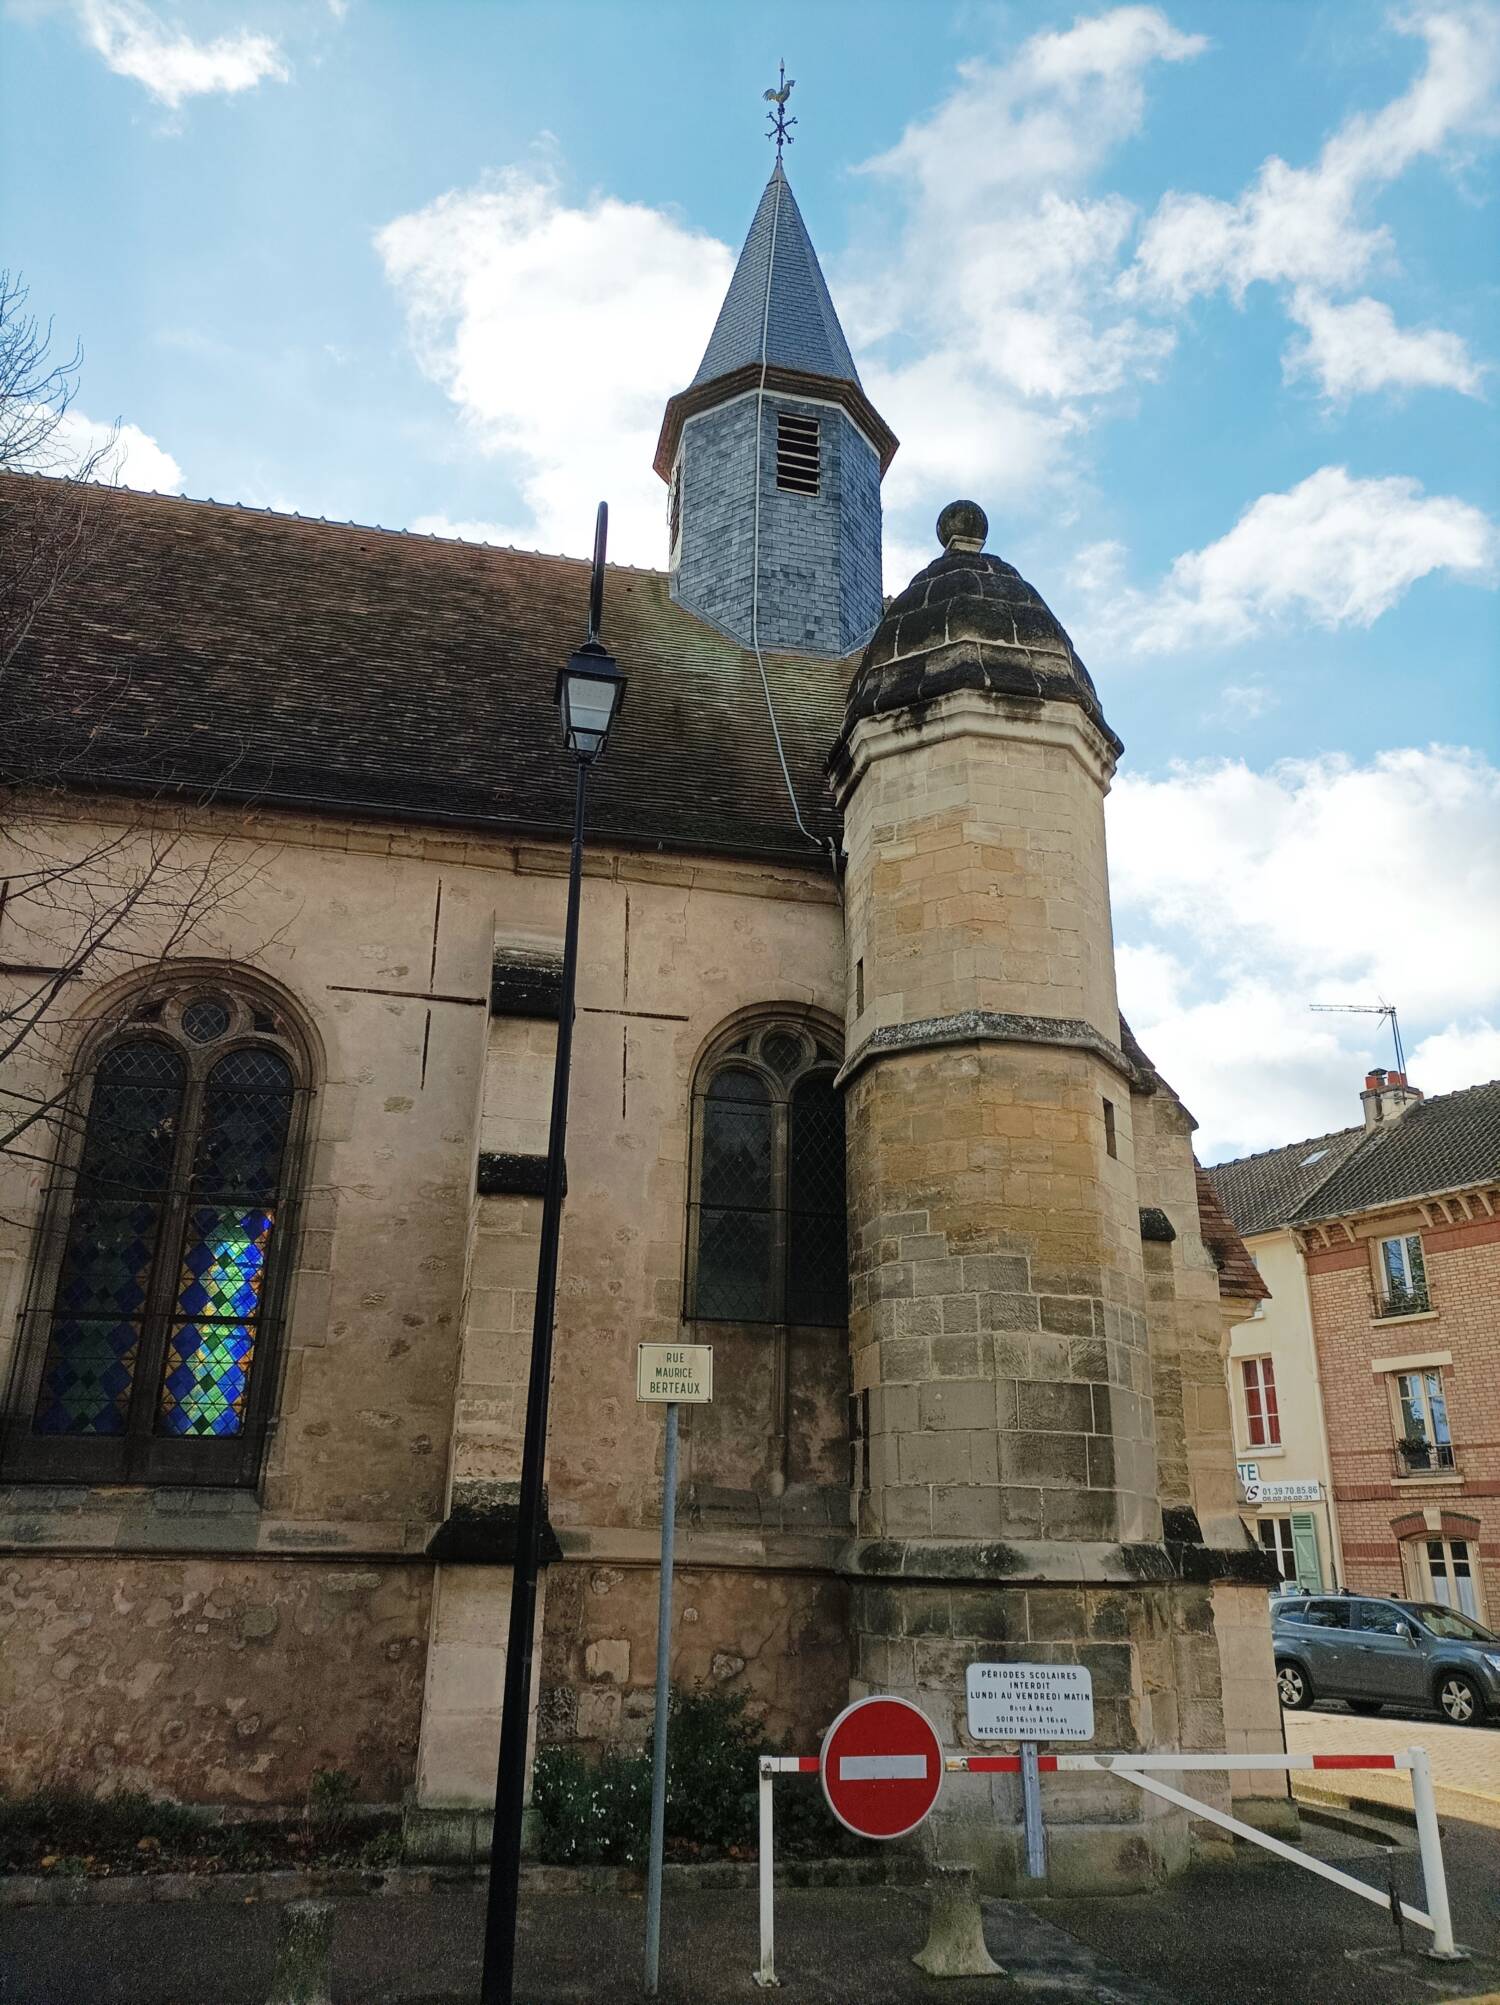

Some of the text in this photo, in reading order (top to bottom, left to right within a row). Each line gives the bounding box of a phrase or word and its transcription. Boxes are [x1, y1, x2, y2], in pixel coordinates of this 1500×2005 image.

[666, 1352, 684, 1363] RUE
[655, 1367, 693, 1378] MAURICE
[650, 1382, 700, 1394] BERTEAUX
[982, 1670, 1077, 1680] PÉRIODES SCOLAIRES
[1016, 1693, 1060, 1701] VENDREDI
[1064, 1693, 1090, 1701] MATIN
